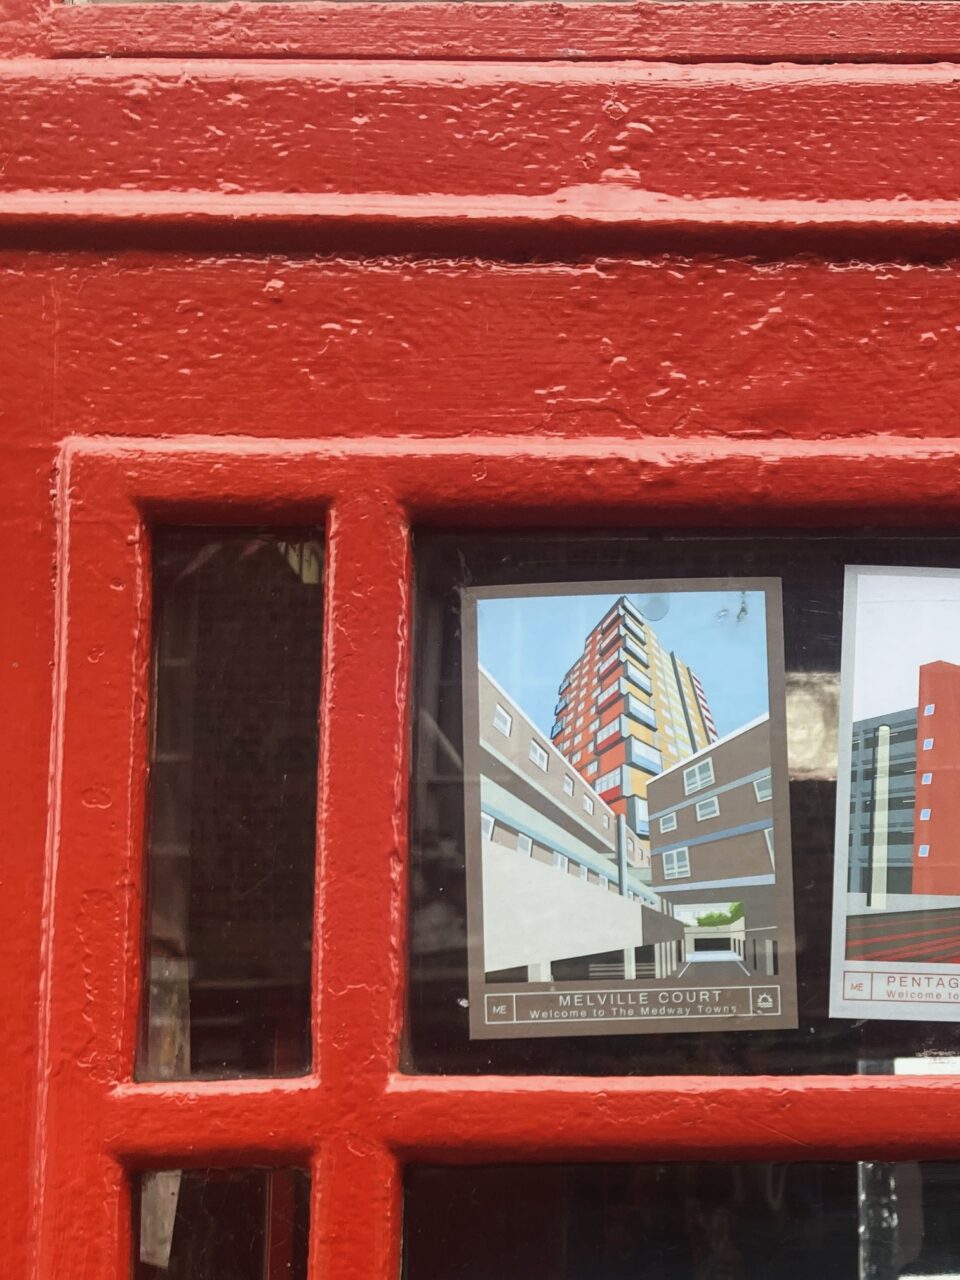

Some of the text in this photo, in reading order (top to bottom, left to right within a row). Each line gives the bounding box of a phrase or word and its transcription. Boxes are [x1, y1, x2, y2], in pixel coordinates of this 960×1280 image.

[850, 982, 864, 991] ME
[559, 991, 722, 1006] MELVILLE COURT
[886, 990, 942, 1000] Welcome
[948, 992, 959, 1000] to
[492, 1005, 507, 1014] ME
[530, 1004, 737, 1019] Welcome to The Medway Towns
